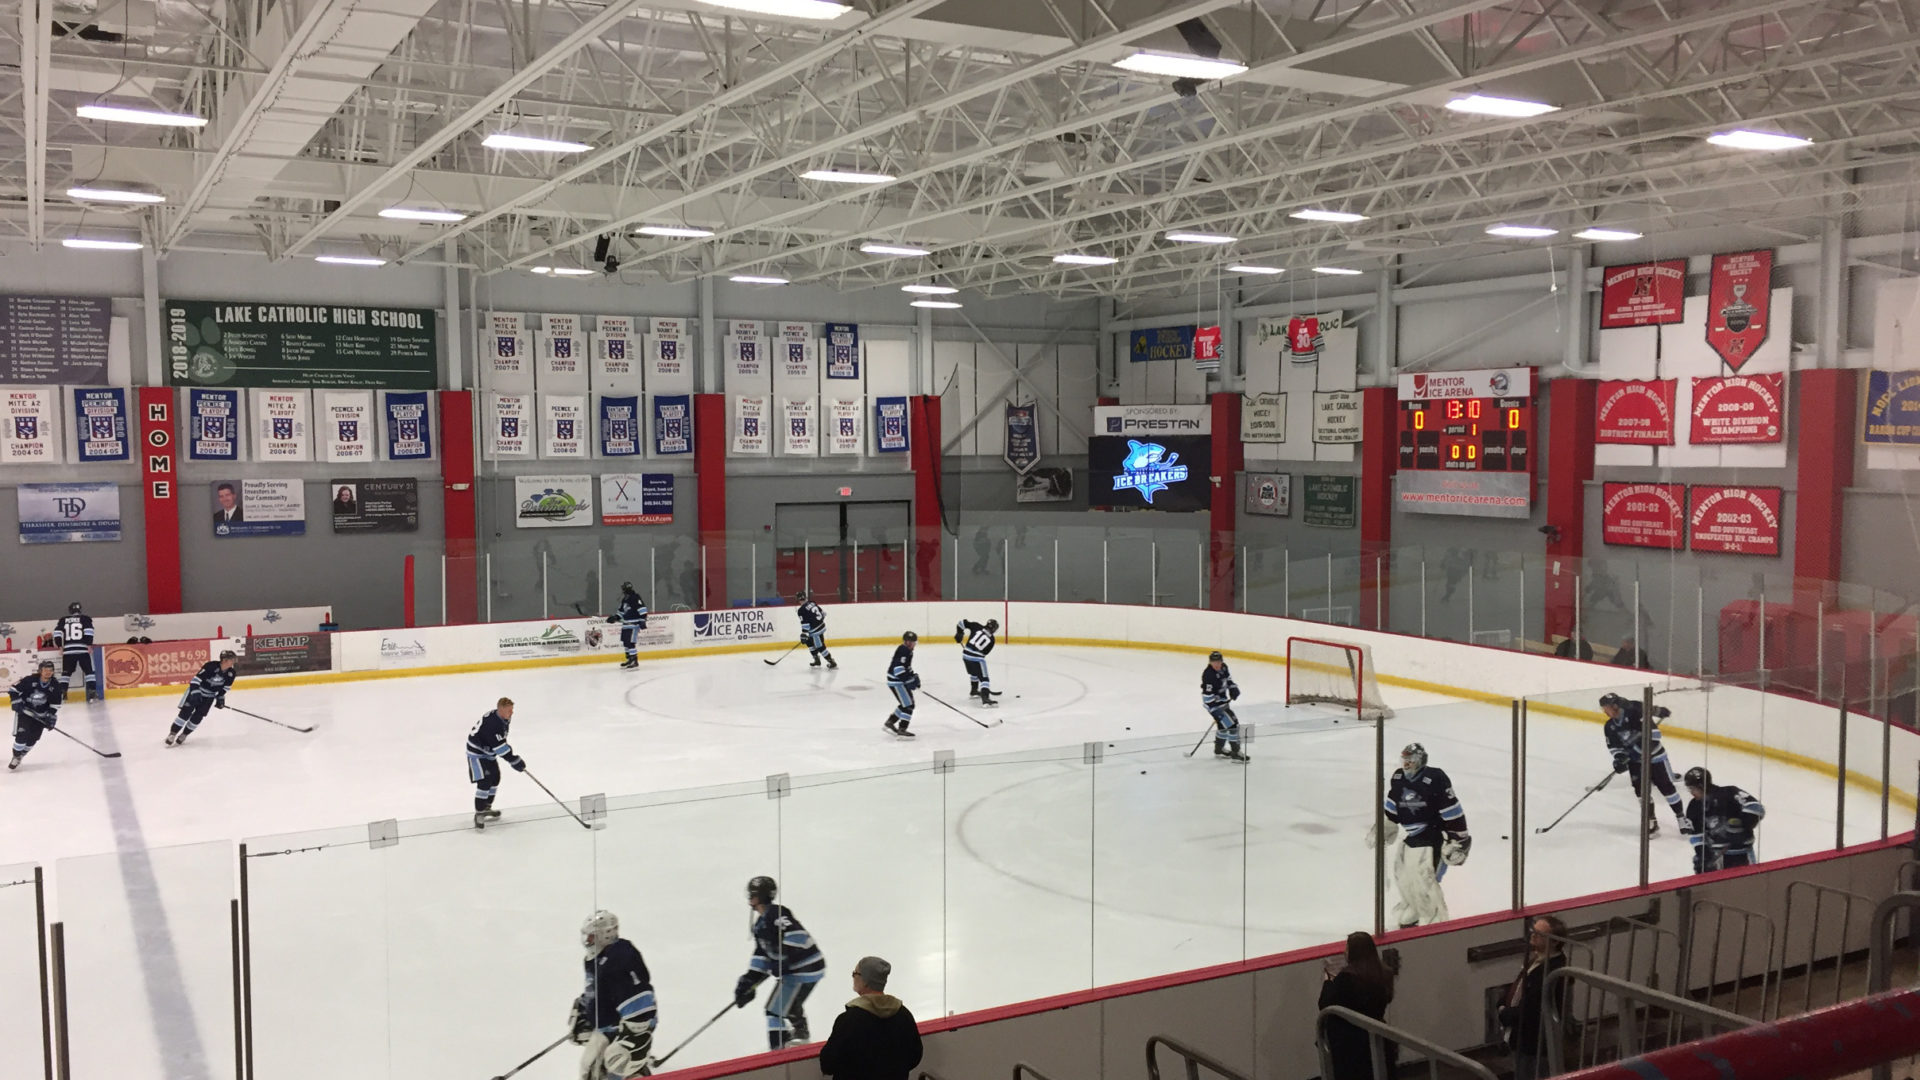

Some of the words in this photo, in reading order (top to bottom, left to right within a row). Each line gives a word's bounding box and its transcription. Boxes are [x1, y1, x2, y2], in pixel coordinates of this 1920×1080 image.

[215, 307, 252, 323] LAKE
[258, 306, 328, 323] CATHOLIC
[333, 308, 366, 325] HIGH
[371, 310, 424, 329] SCHOOL
[1270, 324, 1287, 336] LAK
[170, 308, 188, 379] 2018-2019
[1297, 333, 1310, 348] 30
[1151, 344, 1187, 358] HOCKEY
[1430, 377, 1465, 386] MENTOR
[1429, 389, 1444, 398] ICE
[1445, 387, 1474, 396] ARENA
[1693, 382, 1723, 417] MENTOR
[1724, 378, 1748, 387] HIGH
[1748, 380, 1778, 412] HOCKEY
[1448, 400, 1480, 419] 13:10
[1600, 389, 1625, 421] MENTOR
[1626, 385, 1645, 394] HIGH
[1645, 389, 1670, 422] HOCKEY
[1718, 403, 1754, 411] 2008-09
[1871, 391, 1897, 416] NDCL
[1124, 419, 1200, 429] PRESTAN
[1328, 416, 1346, 424] HOCKEY
[1415, 411, 1424, 430] 0
[1509, 409, 1519, 428] 0
[1702, 418, 1730, 426] WHITE
[1732, 417, 1769, 425] DIVISION
[1448, 425, 1465, 434] period
[1472, 424, 1477, 436] 1
[1600, 430, 1633, 438] DISTRICT
[1633, 430, 1668, 438] FINALIST
[1711, 425, 1757, 434] CHAMPIONS
[148, 404, 171, 499] HOME
[1400, 446, 1413, 454] player
[1419, 446, 1438, 455] penalty
[1452, 445, 1460, 459] 0
[1468, 445, 1476, 459] 0
[1485, 446, 1504, 455] penalty
[1511, 446, 1527, 455] player
[1466, 461, 1476, 469] goal
[1117, 476, 1133, 487] ICE
[1135, 468, 1186, 485] BREAKERS
[1402, 492, 1527, 506] www.mentoricearena.com
[1605, 487, 1634, 515] MENTOR
[1634, 485, 1655, 494] HIGH
[1655, 488, 1683, 518] HOCKEY
[1626, 502, 1659, 512] 2001-02
[1692, 492, 1723, 525] MENTOR
[1723, 489, 1747, 499] HIGH
[1748, 493, 1778, 528] HOCKEY
[1716, 513, 1752, 523] 2002-03
[1695, 532, 1732, 541] UNDEFEATED
[714, 610, 764, 623] MENTOR
[811, 606, 822, 621] 3
[64, 623, 83, 641] 16
[714, 624, 732, 636] ICE
[735, 622, 774, 634] ARENA
[254, 636, 309, 649] KEHMP
[969, 630, 991, 651] 10
[148, 652, 178, 663] MOE
